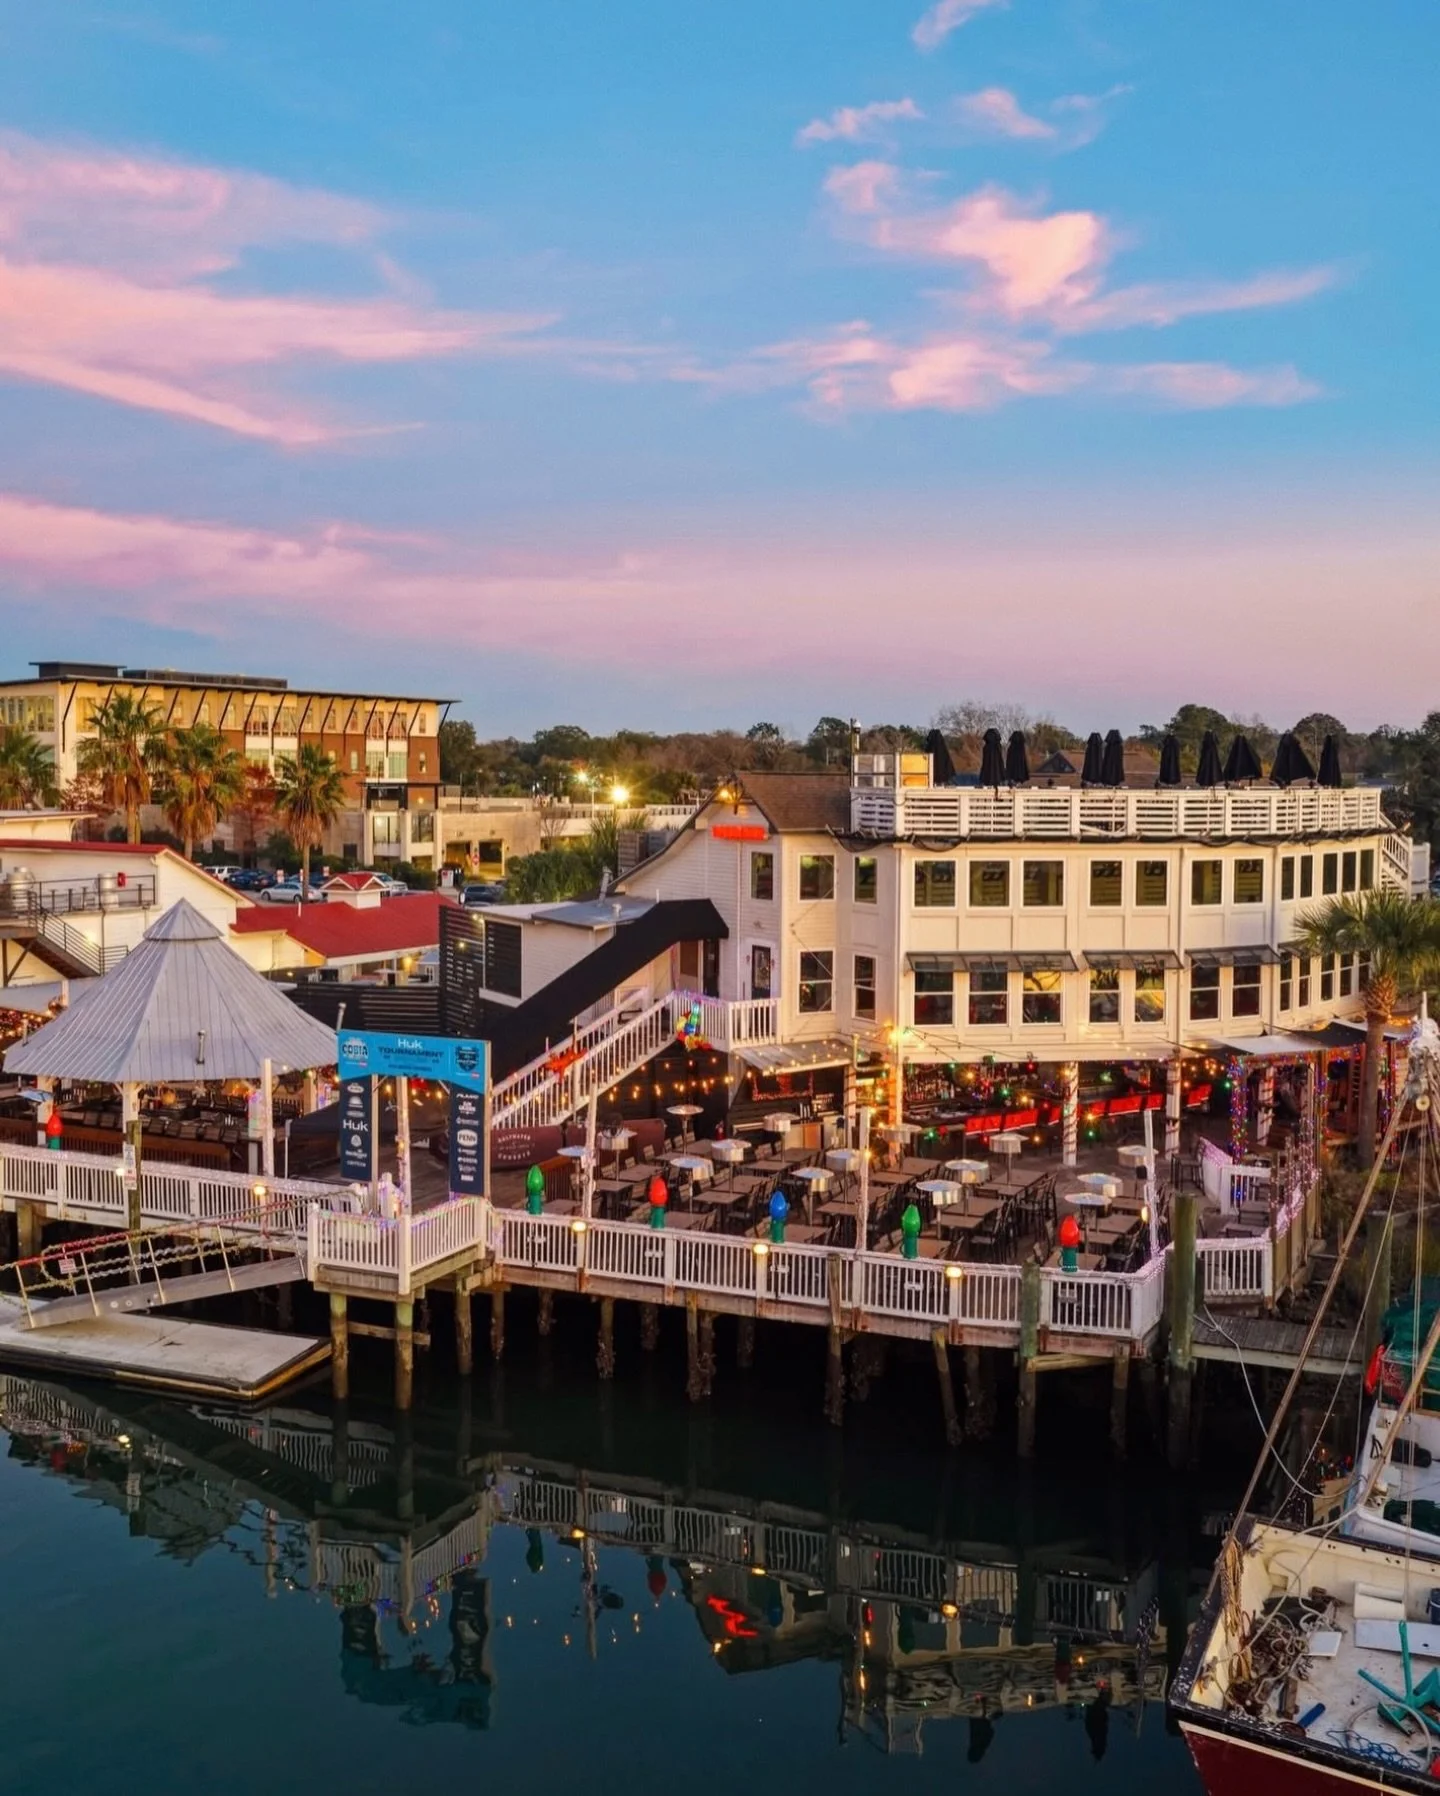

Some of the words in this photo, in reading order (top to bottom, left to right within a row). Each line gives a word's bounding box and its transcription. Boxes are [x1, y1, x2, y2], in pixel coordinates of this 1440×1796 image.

[397, 1037, 423, 1049] Huk
[378, 1046, 445, 1058] TOURNAMENT
[342, 1119, 369, 1132] Huk
